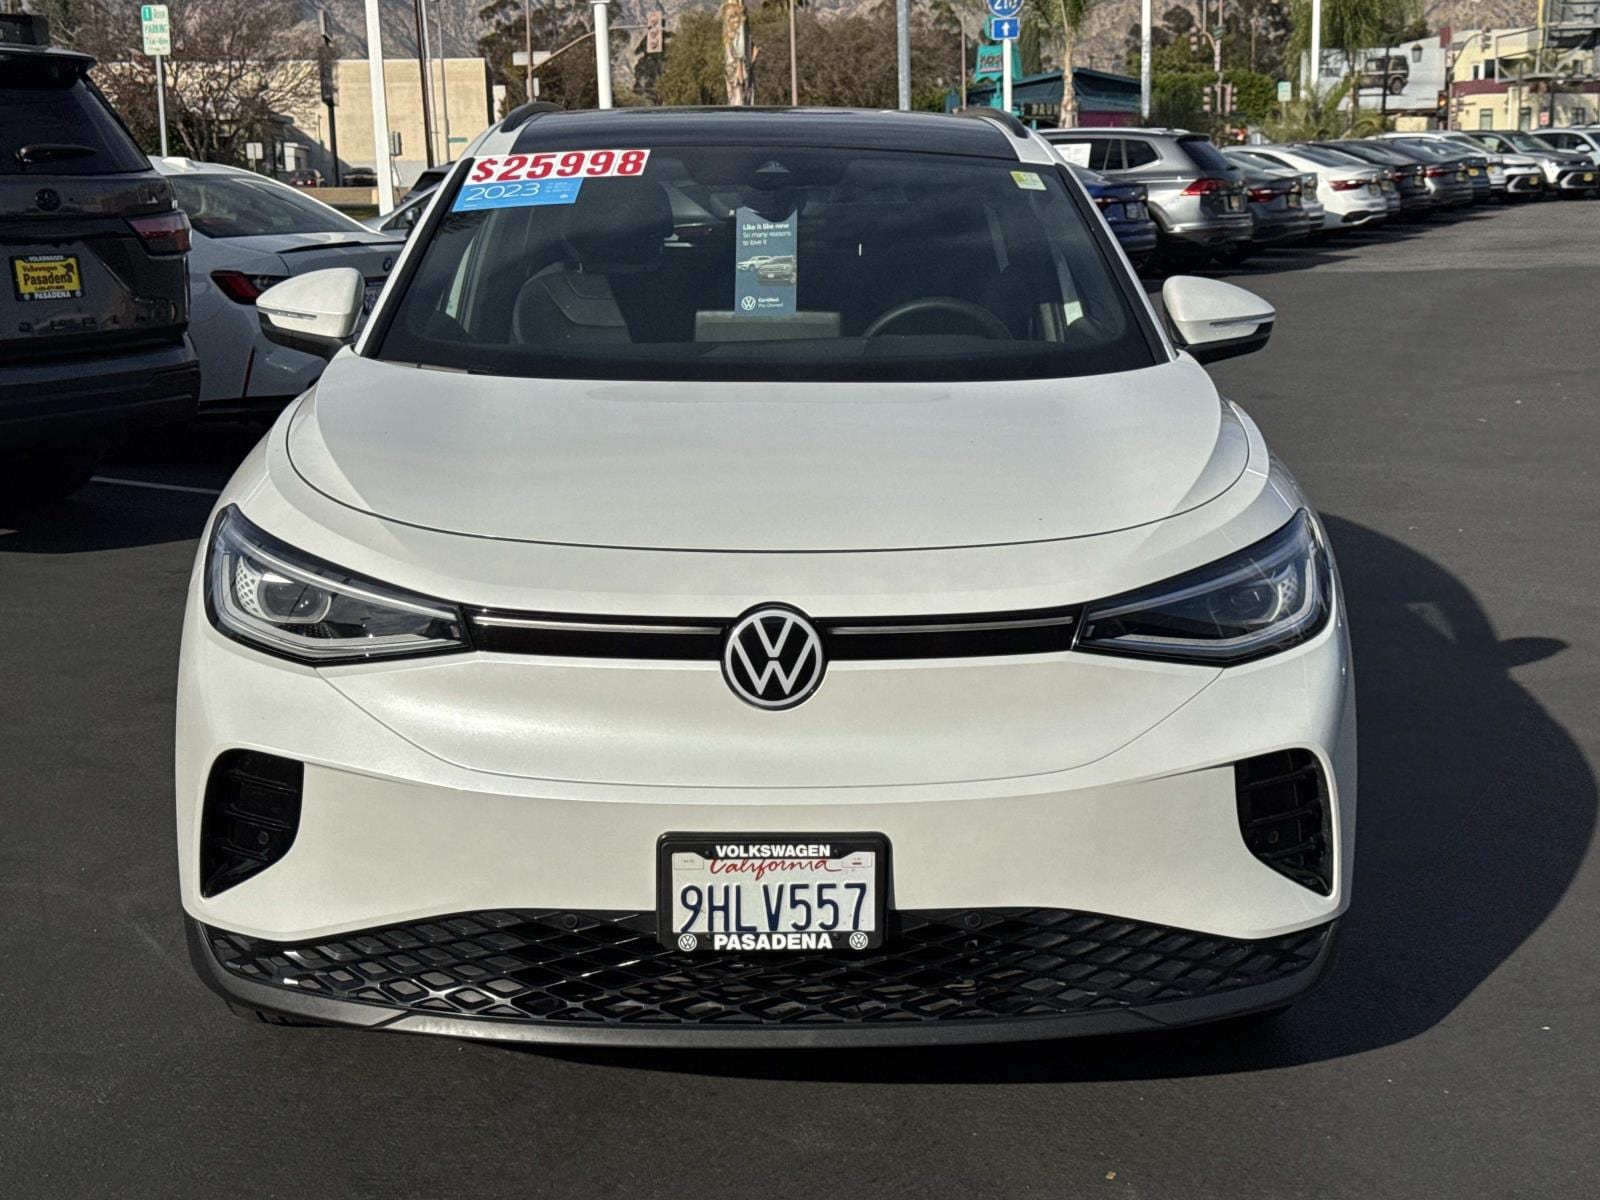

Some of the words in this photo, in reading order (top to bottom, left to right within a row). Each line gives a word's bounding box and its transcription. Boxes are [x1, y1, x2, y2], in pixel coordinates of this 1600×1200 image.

[471, 151, 646, 182] $25998
[465, 183, 541, 201] 2023
[23, 272, 73, 286] Pasadena
[34, 291, 71, 299] PASADENA
[715, 844, 831, 858] VOLKSWAGEN
[709, 858, 843, 881] California
[680, 882, 867, 932] 9HLV557
[714, 933, 833, 950] PASADENA
